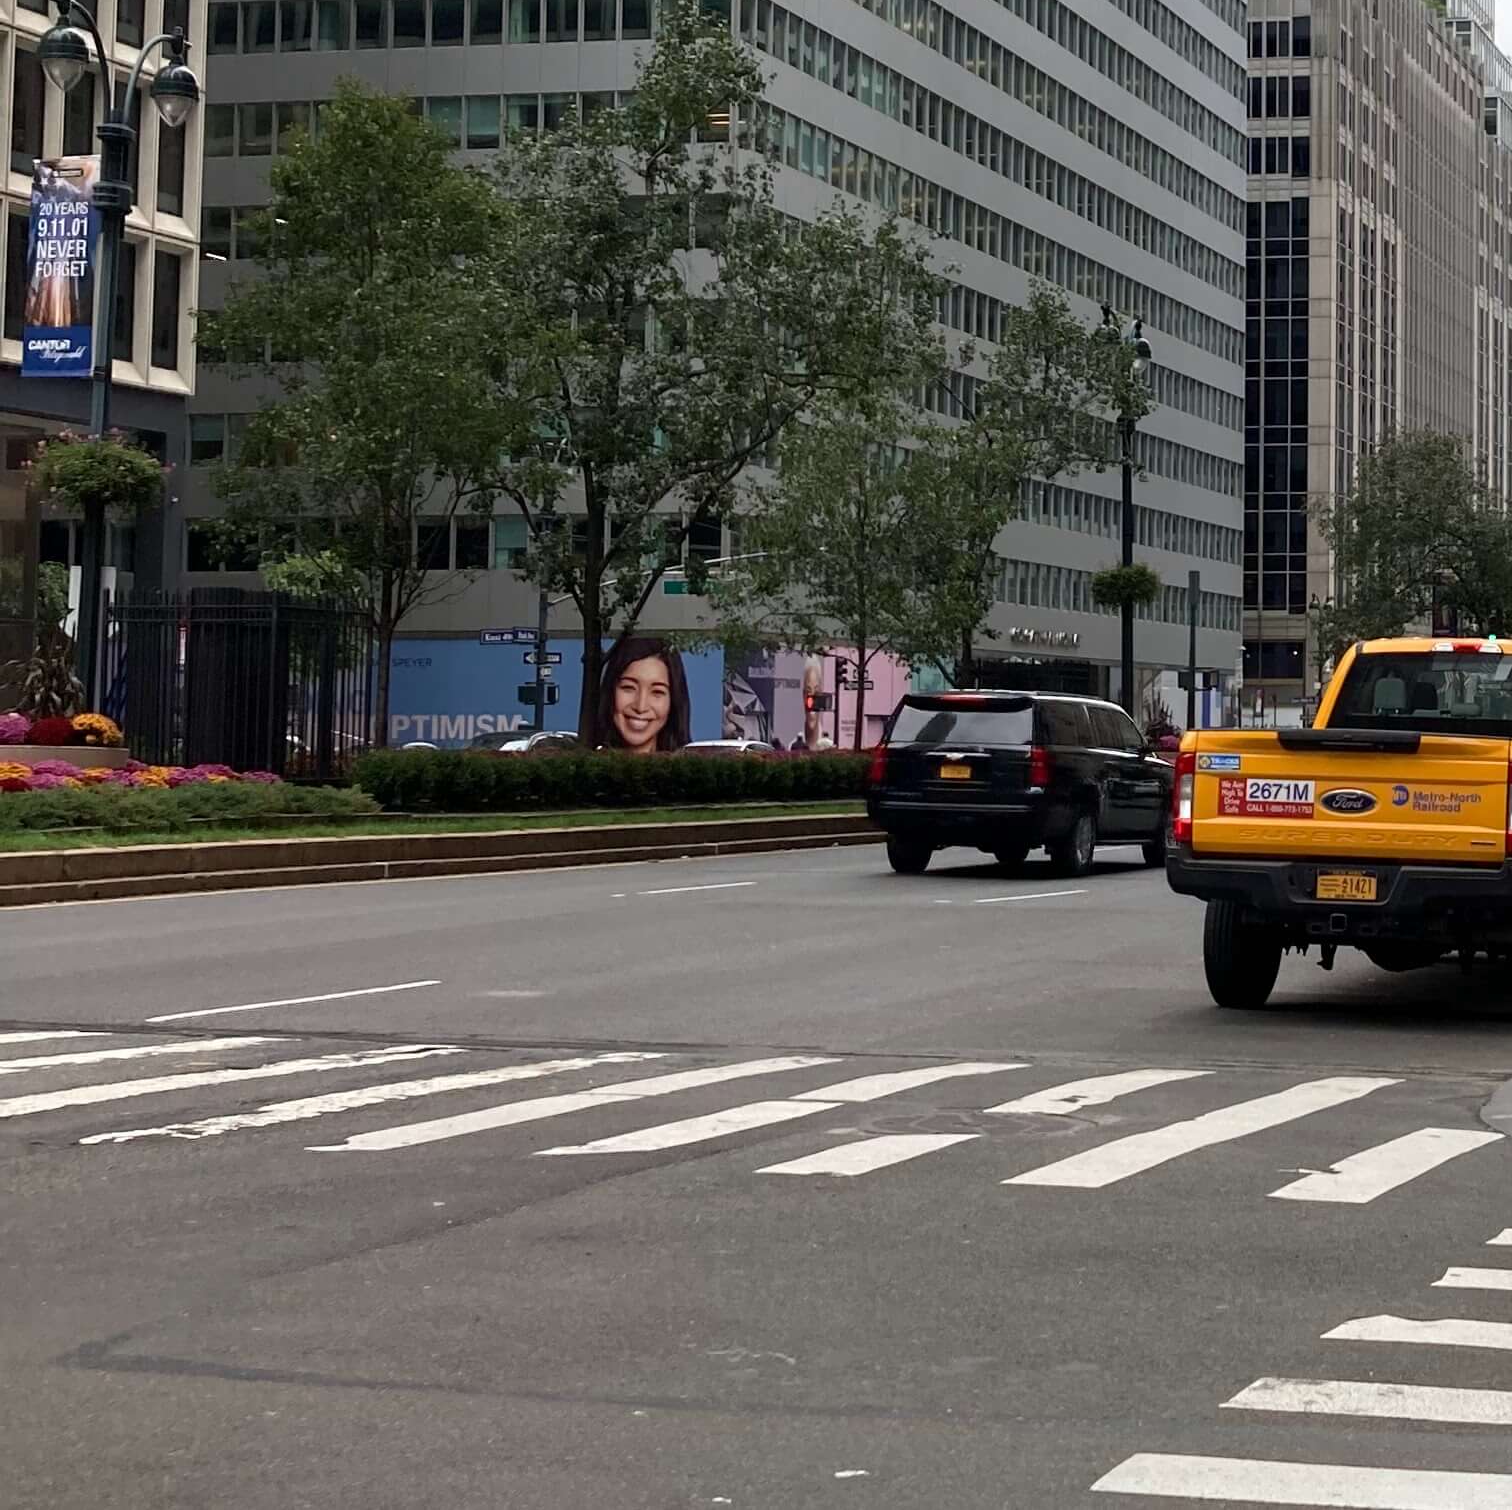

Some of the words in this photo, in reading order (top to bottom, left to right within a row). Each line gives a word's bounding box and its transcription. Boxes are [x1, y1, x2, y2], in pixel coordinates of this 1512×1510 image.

[39, 203, 52, 215] 20
[54, 202, 89, 215] YEARS
[38, 217, 88, 237] 9.11.01
[36, 240, 87, 259] NEVER
[35, 261, 88, 278] FORGET
[370, 714, 524, 740] PTIMISM
[1249, 782, 1309, 801] 2671M
[1413, 791, 1482, 803] Metro-North
[1247, 803, 1264, 812] CALL
[1332, 793, 1364, 809] Ford
[1412, 801, 1461, 812] Railroad
[1240, 828, 1355, 844] SUPER
[1366, 834, 1458, 846] DUTY
